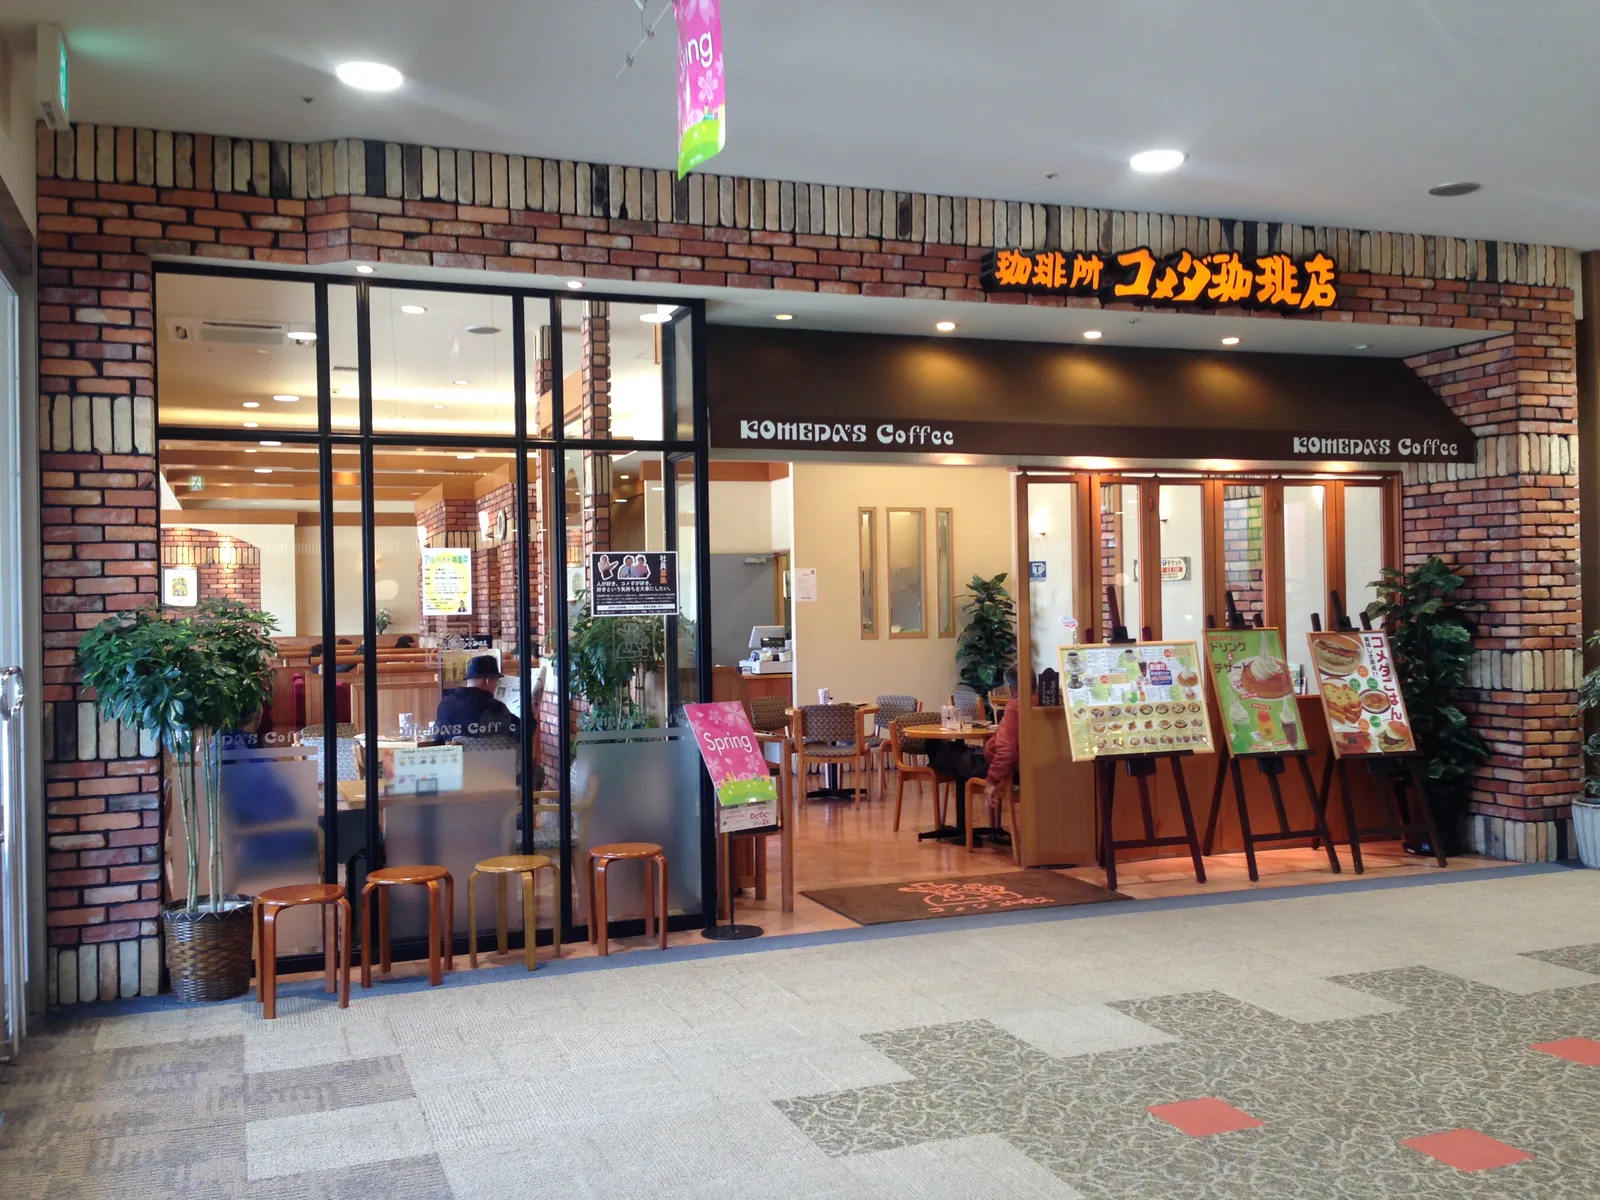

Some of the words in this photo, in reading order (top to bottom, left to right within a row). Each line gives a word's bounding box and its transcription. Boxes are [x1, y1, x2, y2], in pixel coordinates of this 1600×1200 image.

[1114, 249, 1337, 309] コメダ珈琲店
[740, 419, 867, 443] KOMEDA'S
[876, 424, 954, 445] Coffee
[1293, 436, 1391, 456] KOMEDA'S
[1397, 438, 1458, 456] Coffee
[1210, 641, 1246, 652] ドリンク
[703, 732, 753, 756] Spring
